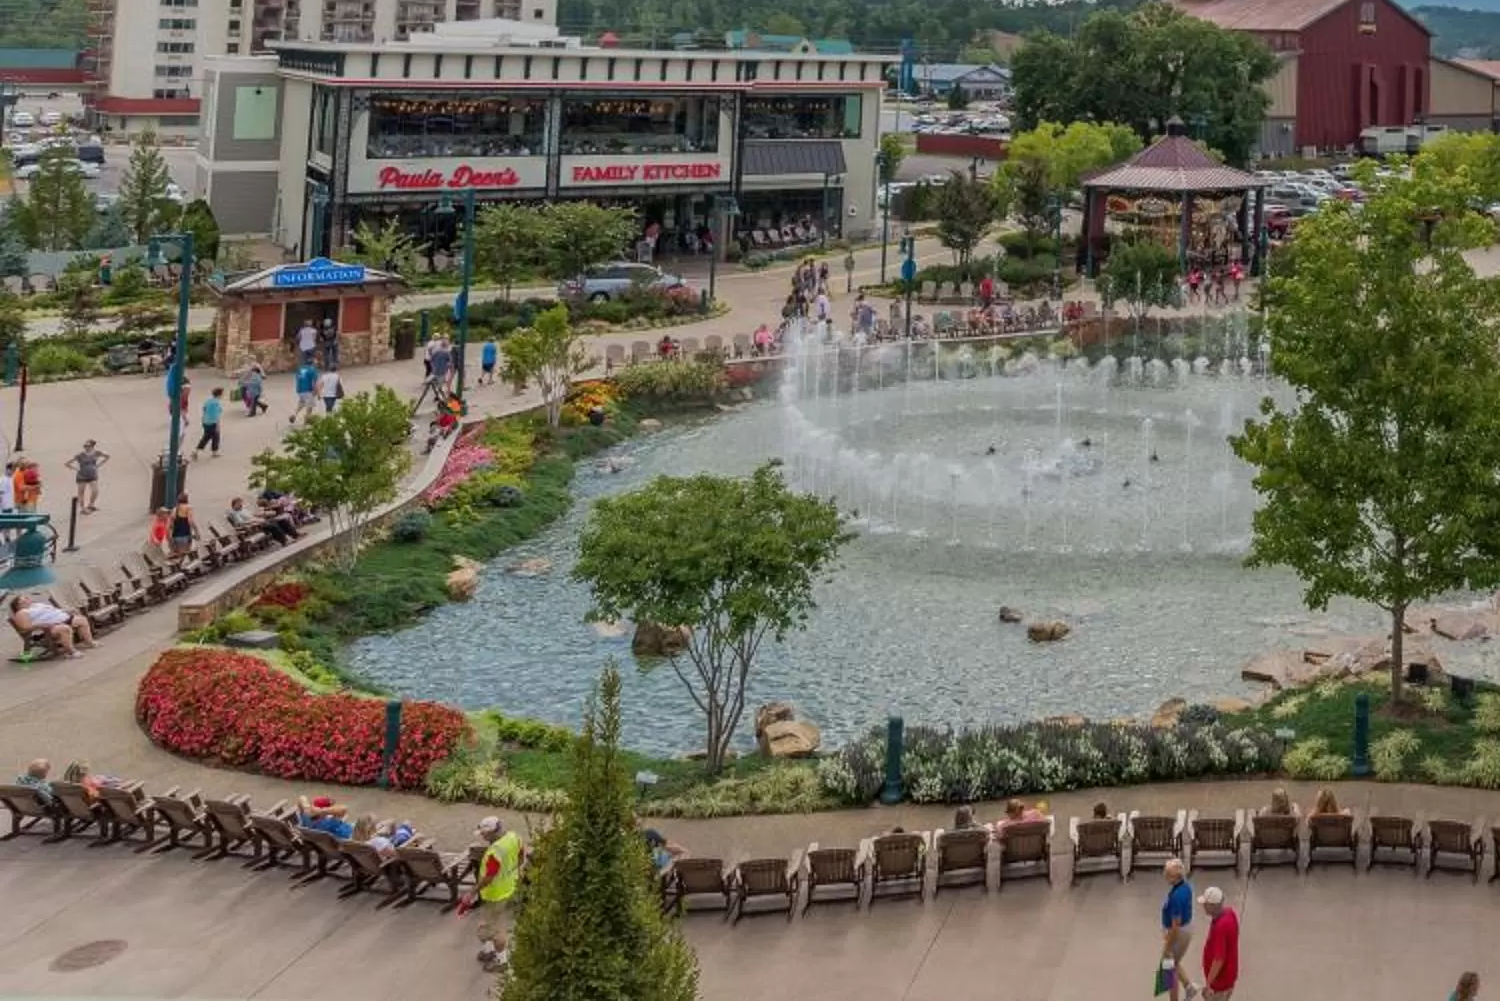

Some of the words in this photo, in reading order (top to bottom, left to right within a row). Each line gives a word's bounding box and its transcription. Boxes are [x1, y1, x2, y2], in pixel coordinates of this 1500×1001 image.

[379, 165, 443, 188] Paula
[448, 164, 520, 188] Deen's
[573, 165, 639, 181] FAMILY
[643, 163, 721, 180] KITCHEN
[277, 269, 362, 284] INFORMATION
